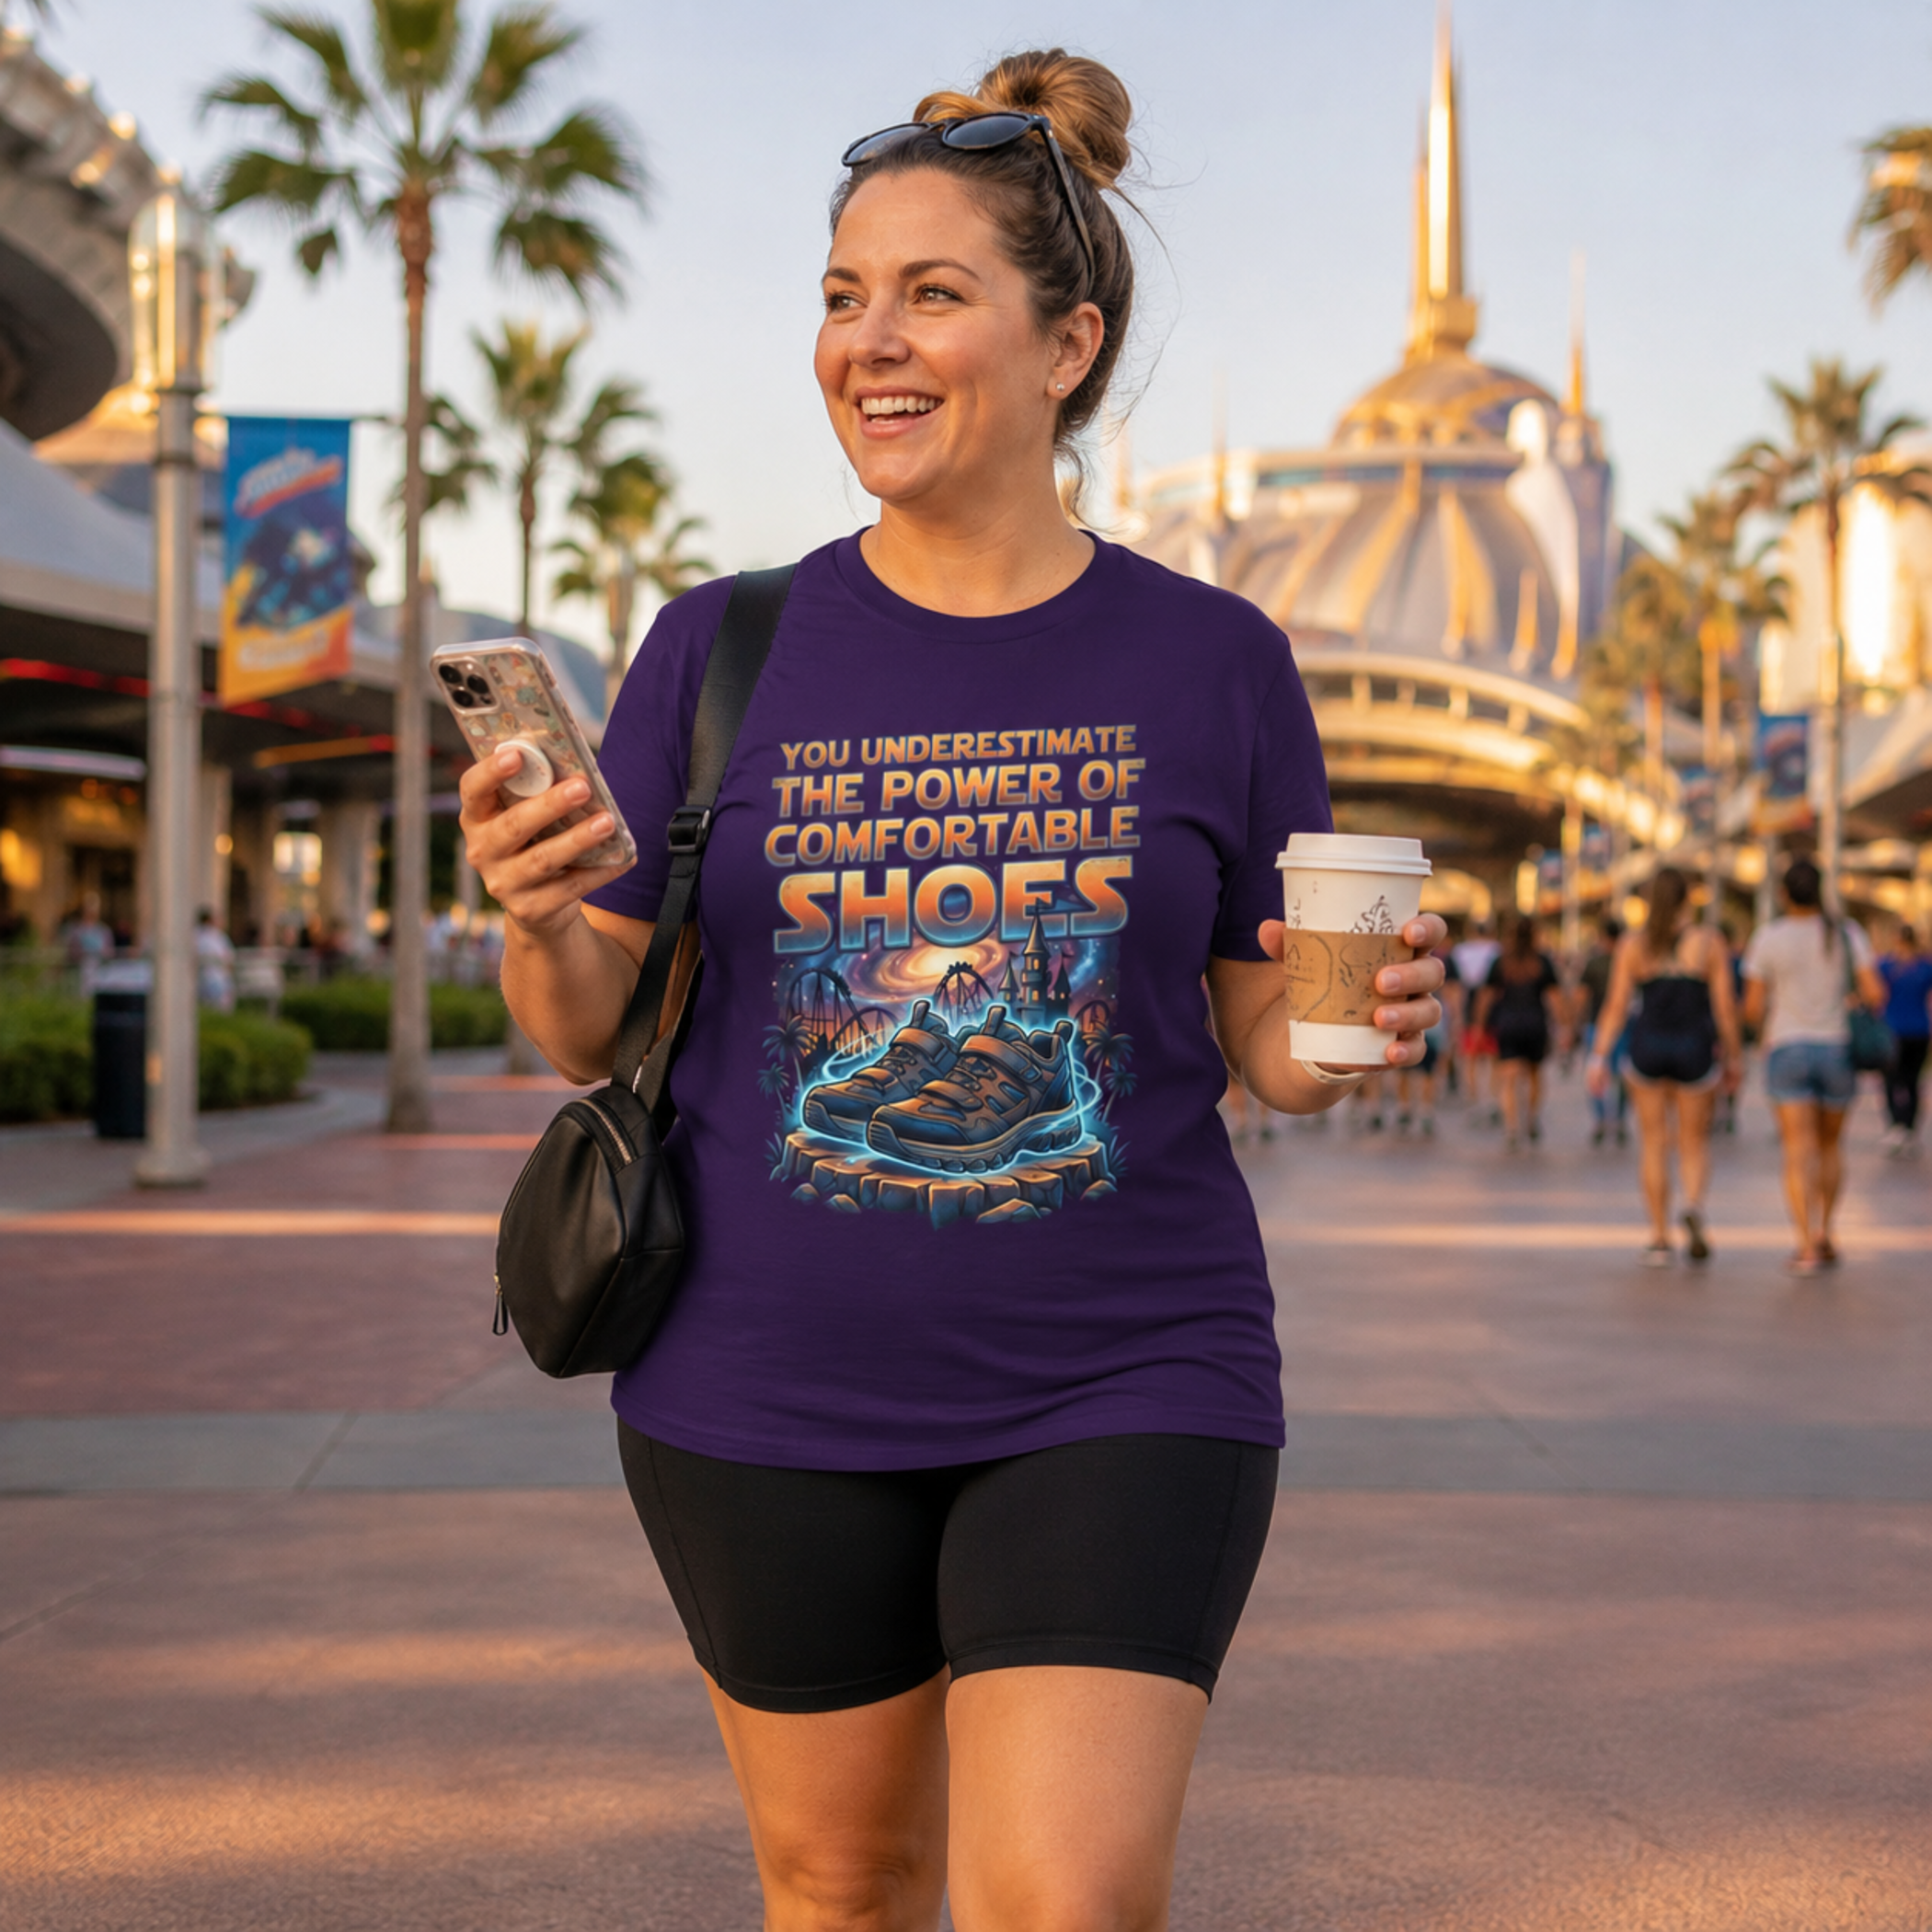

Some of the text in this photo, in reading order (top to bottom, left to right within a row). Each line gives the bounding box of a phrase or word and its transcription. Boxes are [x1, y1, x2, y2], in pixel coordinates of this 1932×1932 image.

[780, 725, 1136, 770] YOU UNDERESTIMATE
[773, 758, 1145, 818] THE POWER OF
[765, 806, 1141, 867] COMFORTABLE
[774, 856, 1133, 954] SHOES
